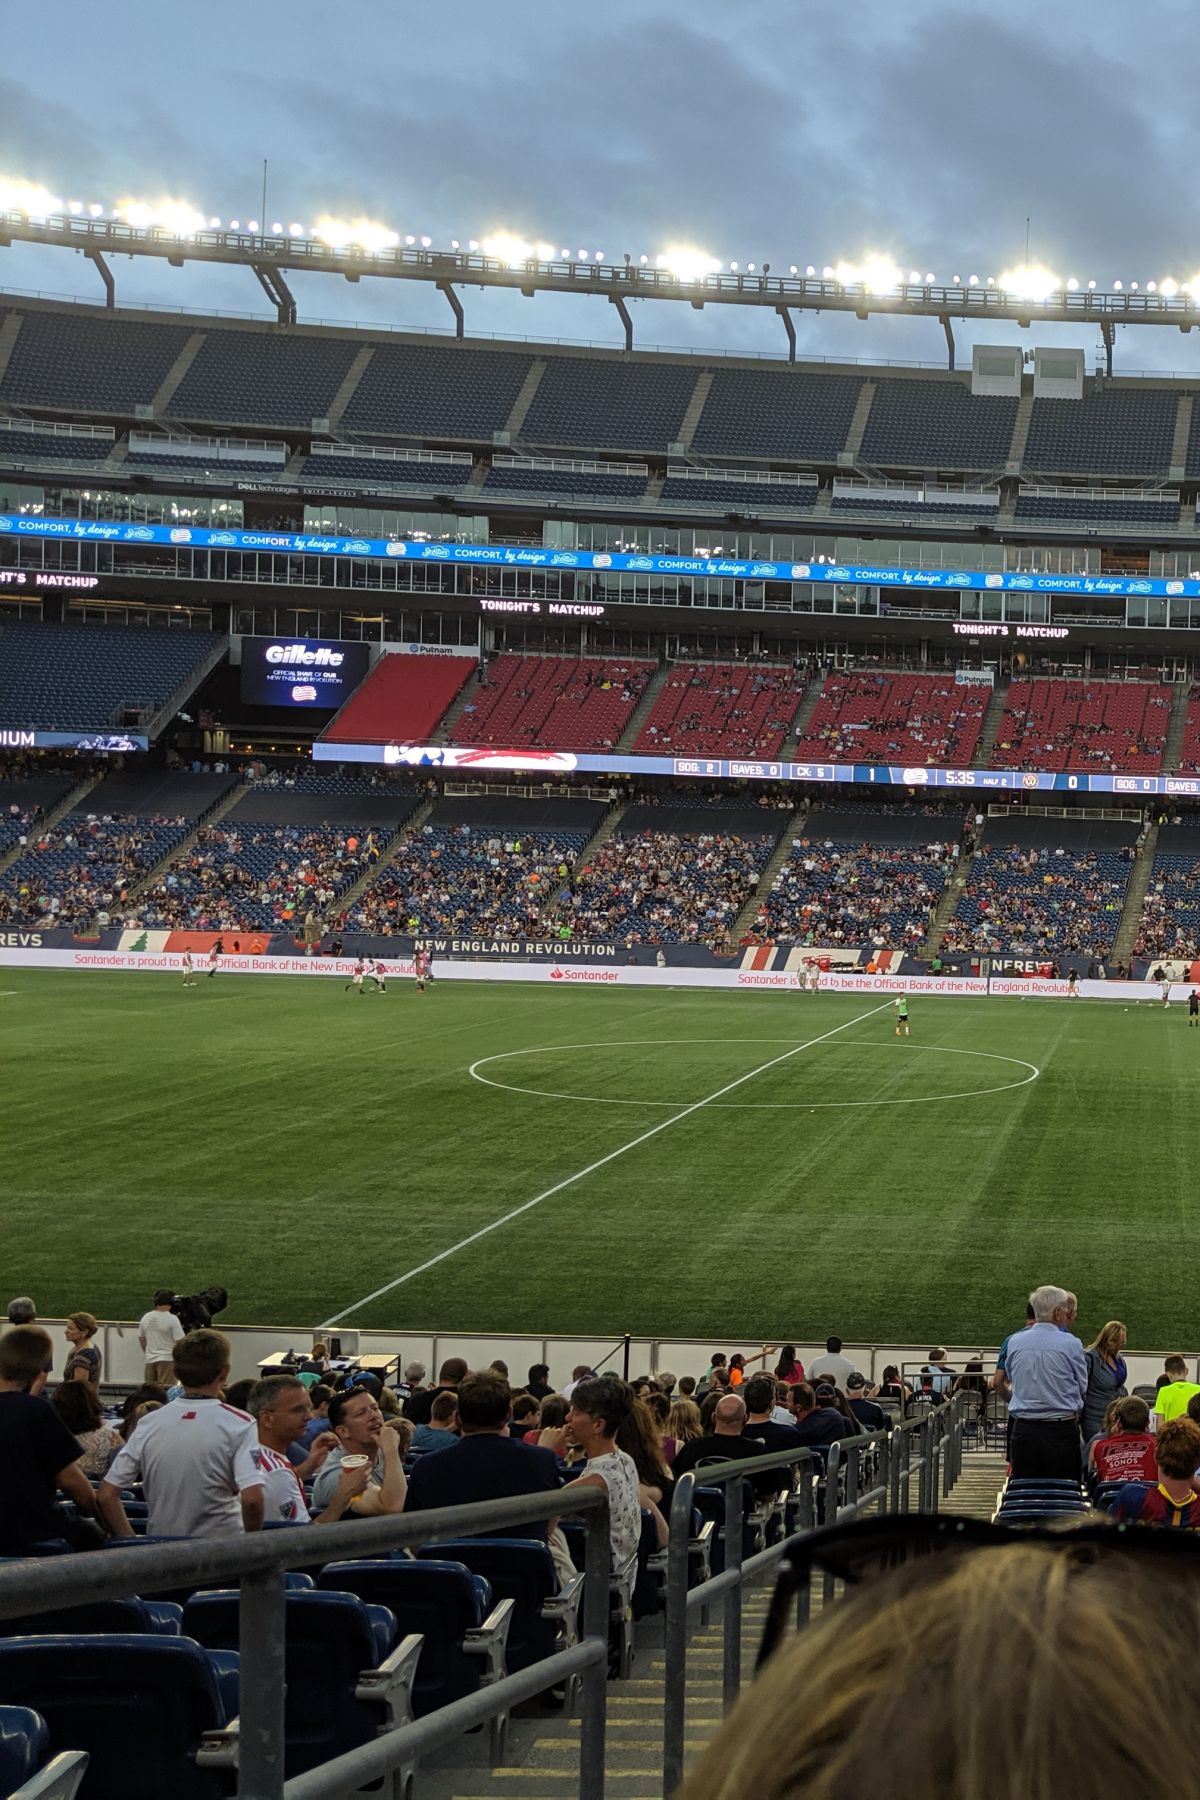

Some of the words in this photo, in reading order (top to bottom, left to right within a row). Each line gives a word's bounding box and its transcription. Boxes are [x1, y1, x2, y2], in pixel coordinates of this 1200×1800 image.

[18, 521, 72, 534] COMFORT,
[74, 522, 86, 537] by
[241, 535, 293, 548] COMFORT,
[294, 536, 306, 551] by
[454, 549, 503, 561] COMFORT,
[504, 549, 516, 563] by
[658, 560, 704, 571] COMFORT,
[706, 560, 717, 574] by
[36, 574, 98, 588] MATCHUP
[855, 571, 900, 581] COMFORT,
[902, 571, 913, 584] by
[1038, 579, 1083, 590] COMFORT,
[1084, 579, 1094, 593] by
[480, 600, 540, 613] TONIGHT'S
[549, 604, 605, 616] MATCHUP
[953, 624, 1009, 635] TONIGHT'S
[1016, 627, 1069, 638] MATCHUP
[265, 644, 345, 666] Gillette
[420, 646, 453, 654] Putnam
[266, 674, 281, 682] NEW
[964, 676, 992, 684] Putnam
[0, 732, 35, 746] IUM
[678, 762, 700, 772] SOG:
[706, 763, 713, 773] 2
[731, 766, 765, 775] SAVES:
[770, 766, 777, 775] 0
[796, 767, 812, 776] CK:
[817, 768, 825, 777] 5
[870, 768, 875, 781] 1
[945, 771, 975, 784] 5:35
[1001, 778, 1007, 786] 2
[1068, 776, 1077, 788] 0
[1116, 780, 1138, 789] SOG:
[1143, 780, 1149, 789] 0
[414, 939, 447, 951] NEW
[452, 941, 520, 953] ENGLAND
[525, 943, 616, 956] REVOLUTION
[75, 954, 125, 965] Santander
[128, 955, 135, 965] is
[138, 956, 166, 968] proud
[169, 957, 178, 967] to
[197, 958, 211, 968] the
[217, 958, 250, 969] Official
[253, 960, 276, 970] Bank
[280, 960, 290, 970] of
[292, 961, 308, 971] the
[310, 961, 333, 972] New
[564, 970, 619, 981] Santander
[738, 973, 787, 986] Santander
[790, 975, 798, 986] is
[842, 977, 854, 987] be
[856, 978, 871, 988] the
[874, 978, 906, 990] Official
[909, 980, 932, 990] Bank
[935, 980, 945, 990] of
[947, 980, 964, 991] the
[967, 981, 988, 992] New
[992, 982, 1029, 994] England
[1109, 1457, 1138, 1468] SONOS
